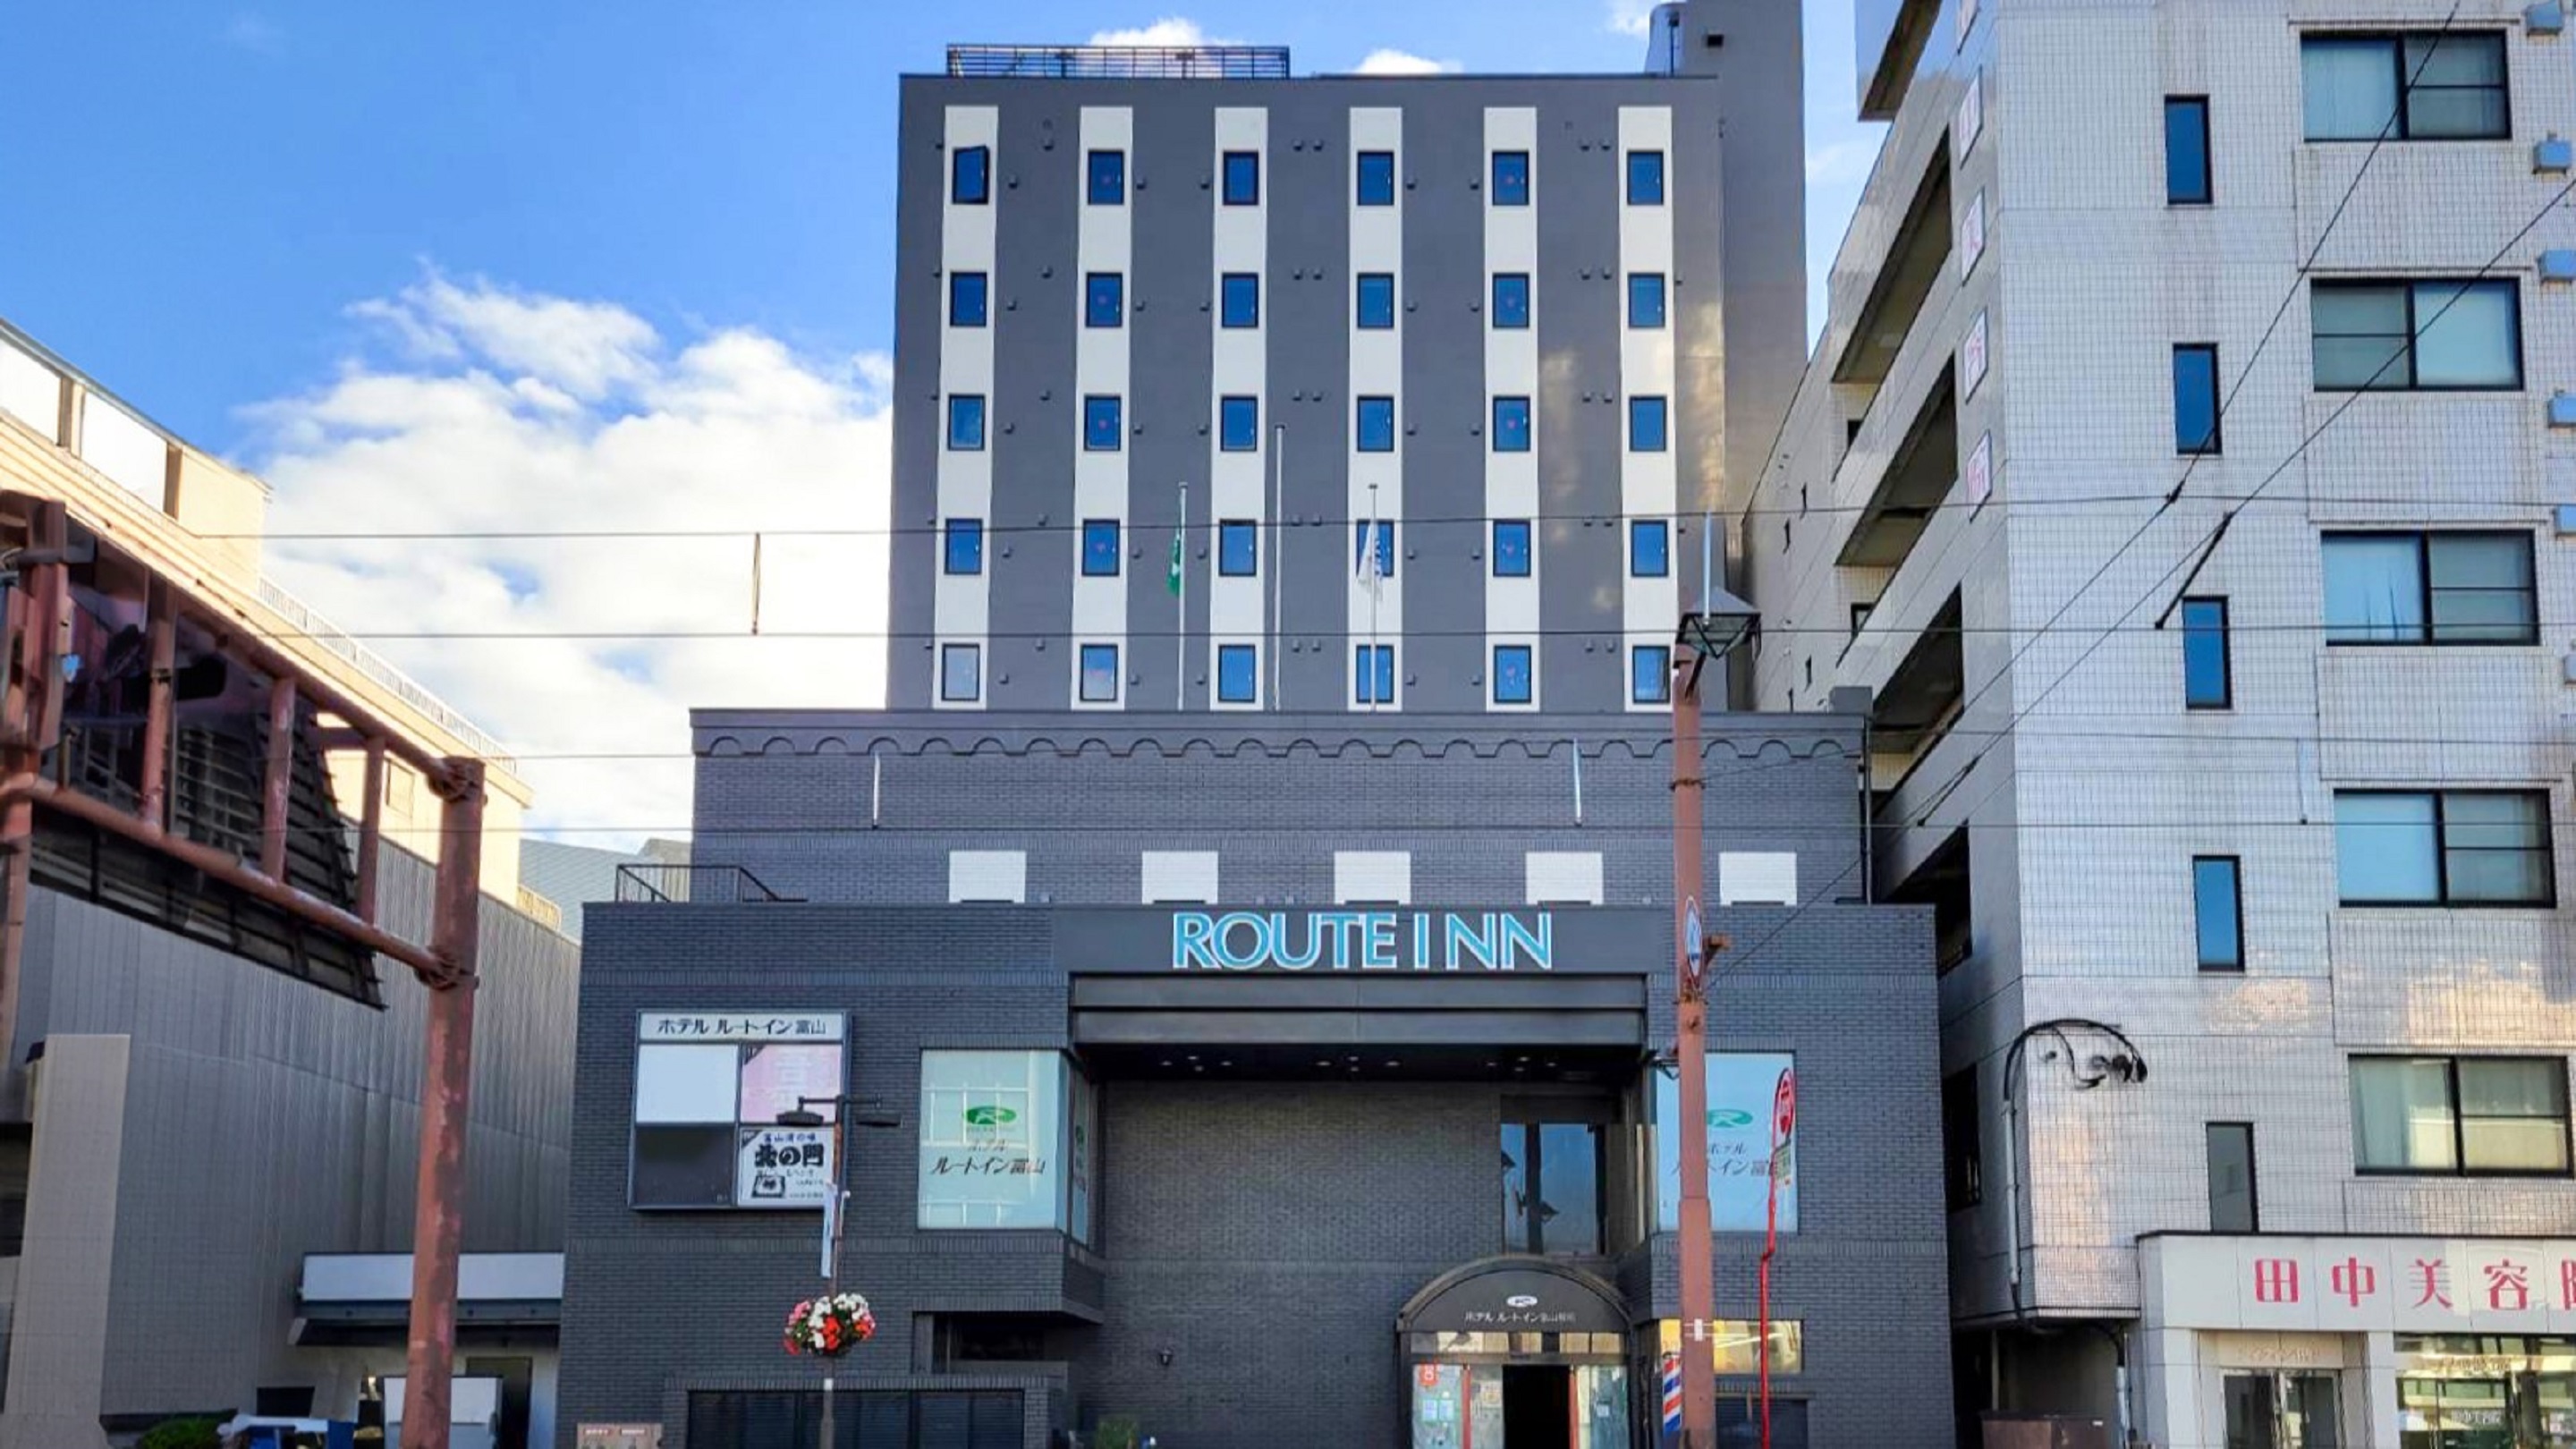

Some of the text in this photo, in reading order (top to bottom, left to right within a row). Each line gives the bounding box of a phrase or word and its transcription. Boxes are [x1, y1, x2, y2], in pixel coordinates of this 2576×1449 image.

[1172, 911, 1553, 970] ROUTE INN
[657, 1019, 826, 1035] ホテル ルートイン富山
